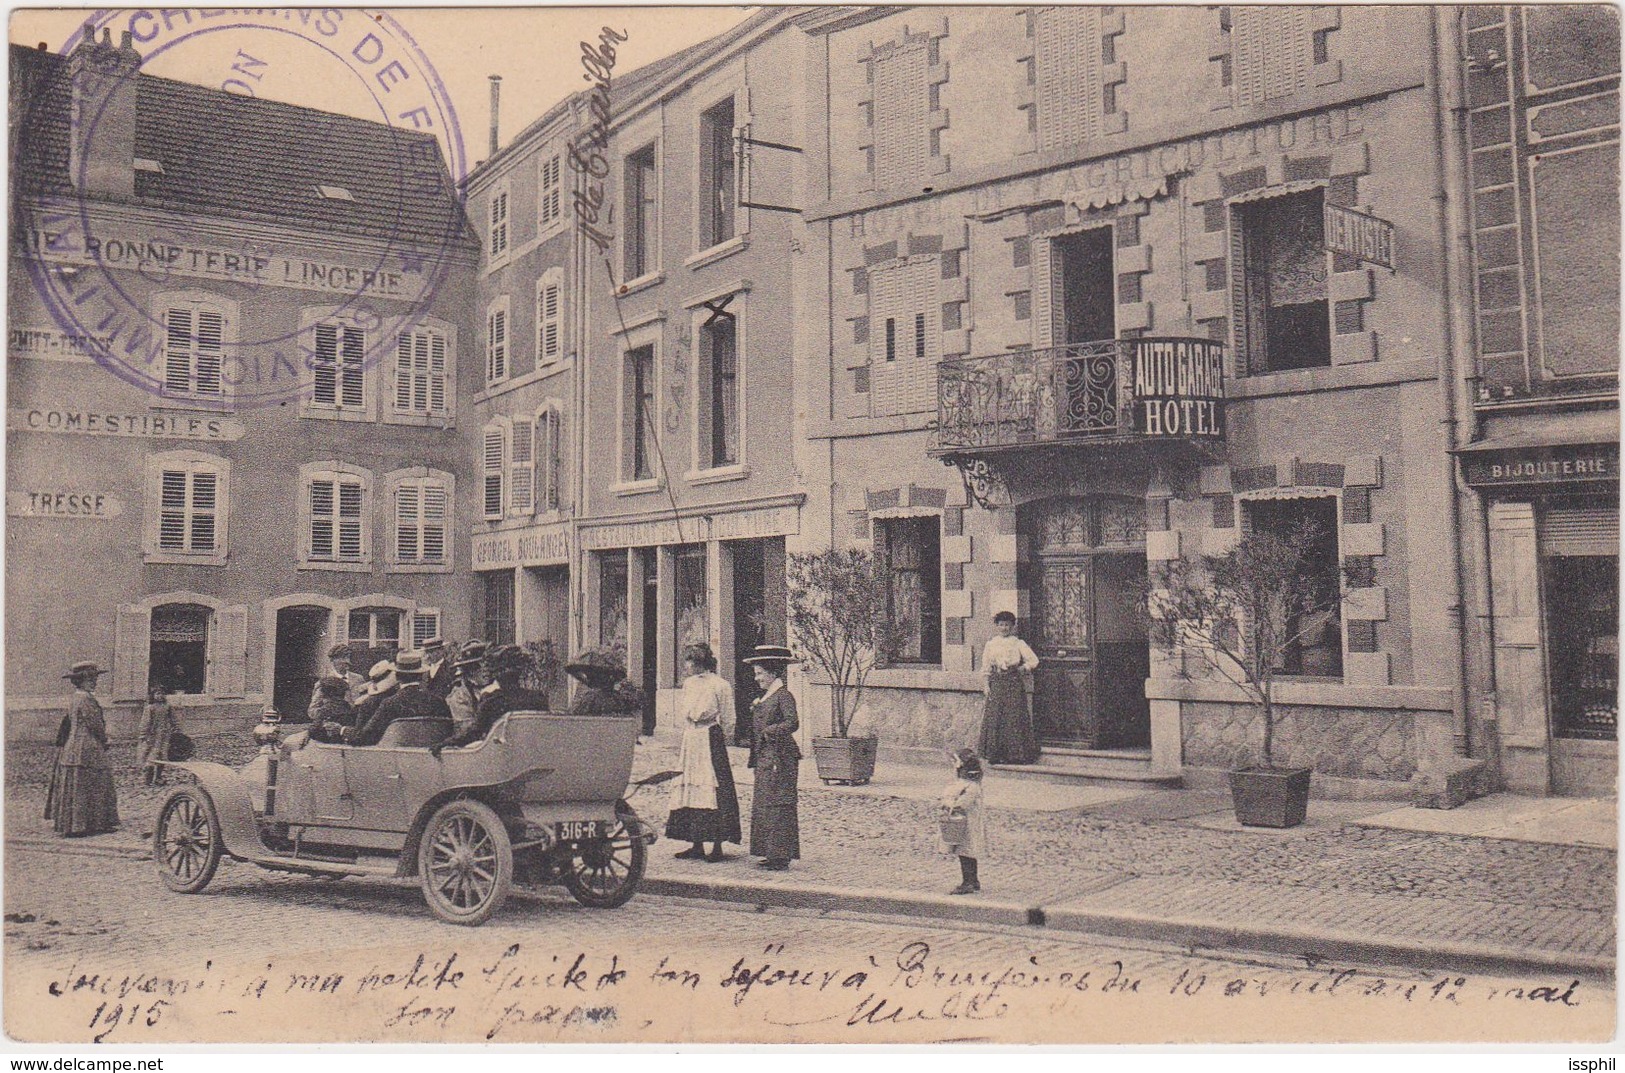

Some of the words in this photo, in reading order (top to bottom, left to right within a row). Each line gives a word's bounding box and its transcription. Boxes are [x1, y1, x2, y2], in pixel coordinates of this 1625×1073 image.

[127, 8, 345, 43] CHNS
[352, 32, 410, 94] DE
[1326, 206, 1391, 263] DENTISTE
[84, 236, 270, 280] BONNETERIE
[283, 259, 402, 296] LINGERIE
[1135, 342, 1175, 396] AUTO
[1177, 343, 1223, 398] GARAGE
[1143, 400, 1220, 435] HOTEL
[1491, 458, 1607, 478] BIJOUTERIE
[28, 492, 106, 516] TRESSE
[561, 821, 597, 839] 316-R
[285, 972, 343, 994] ma
[356, 953, 464, 995] petite
[1101, 960, 1141, 993] du
[1169, 968, 1208, 996] 10
[1430, 976, 1467, 1005] 12
[89, 999, 175, 1043] 1915
